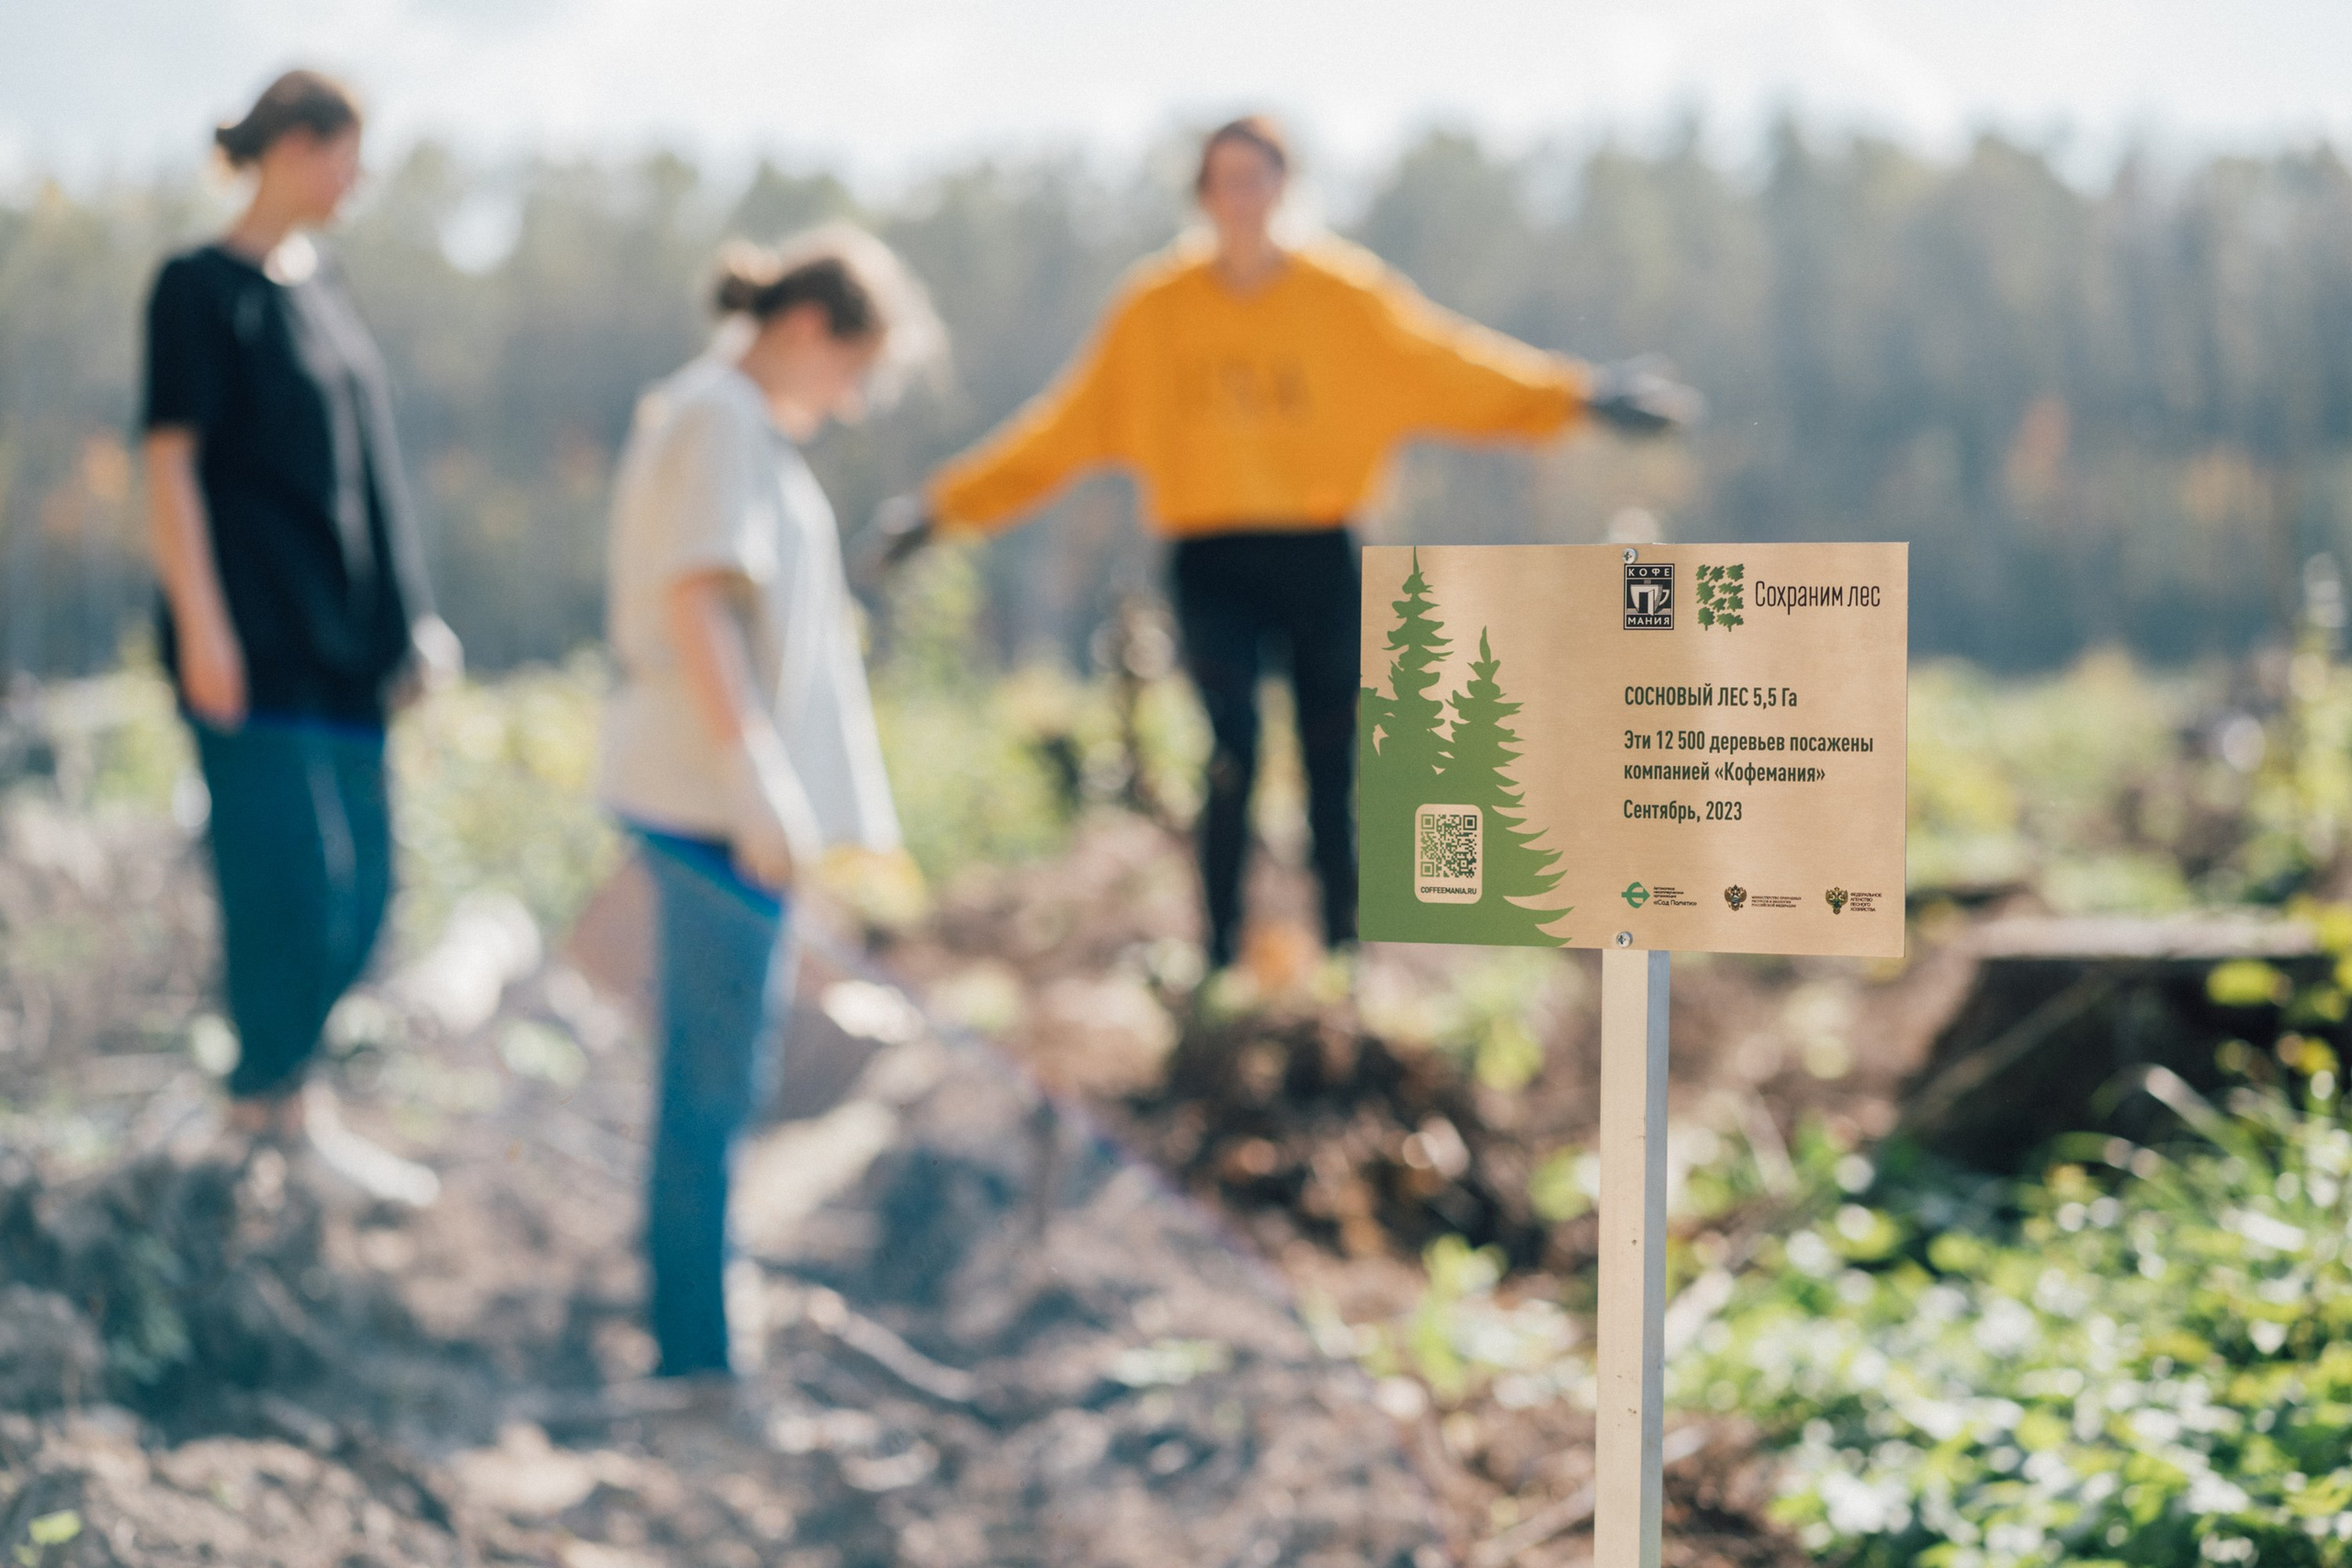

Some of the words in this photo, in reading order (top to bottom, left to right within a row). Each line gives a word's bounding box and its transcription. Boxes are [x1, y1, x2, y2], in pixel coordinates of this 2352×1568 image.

[1628, 568, 1670, 577] КОФЕ
[1755, 581, 1843, 615] Сохраним
[1847, 585, 1881, 607] лес
[1627, 616, 1670, 626] МАНИЯ
[1624, 682, 1713, 706] СОСНОВЫЙ
[1717, 687, 1749, 706] ЛЕС
[1753, 687, 1777, 709] 5,5
[1781, 688, 1798, 707] Га
[1623, 730, 1652, 750] Эти
[1656, 730, 1674, 750] 12
[1678, 730, 1705, 750] 500
[1709, 735, 1785, 755] деревьев
[1790, 736, 1873, 752] посажены
[1623, 761, 1710, 781] компанией
[1714, 761, 1826, 785] «Кофемания»
[1623, 799, 1701, 824] Сентябрь,
[1705, 801, 1743, 820] 2023
[1420, 886, 1477, 895] COFFEEMANIA.RU
